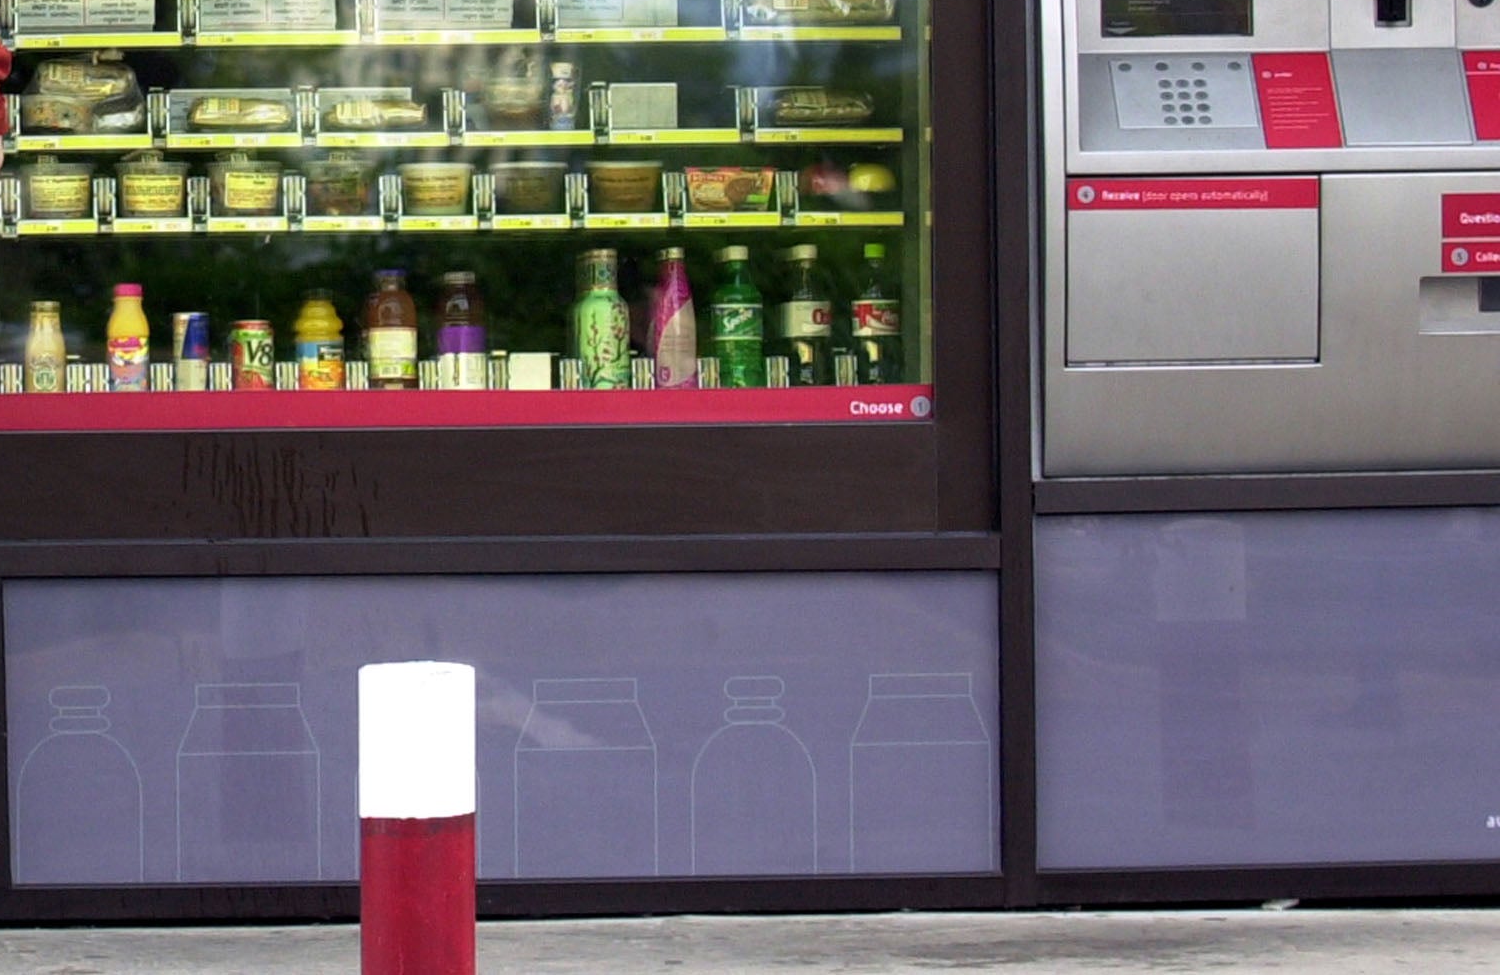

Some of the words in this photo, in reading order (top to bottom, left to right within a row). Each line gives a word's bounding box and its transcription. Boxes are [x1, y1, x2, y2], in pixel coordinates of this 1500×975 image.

[1101, 190, 1140, 201] Receive
[1169, 192, 1199, 203] opens
[245, 339, 274, 367] V8
[850, 400, 904, 415] Choose
